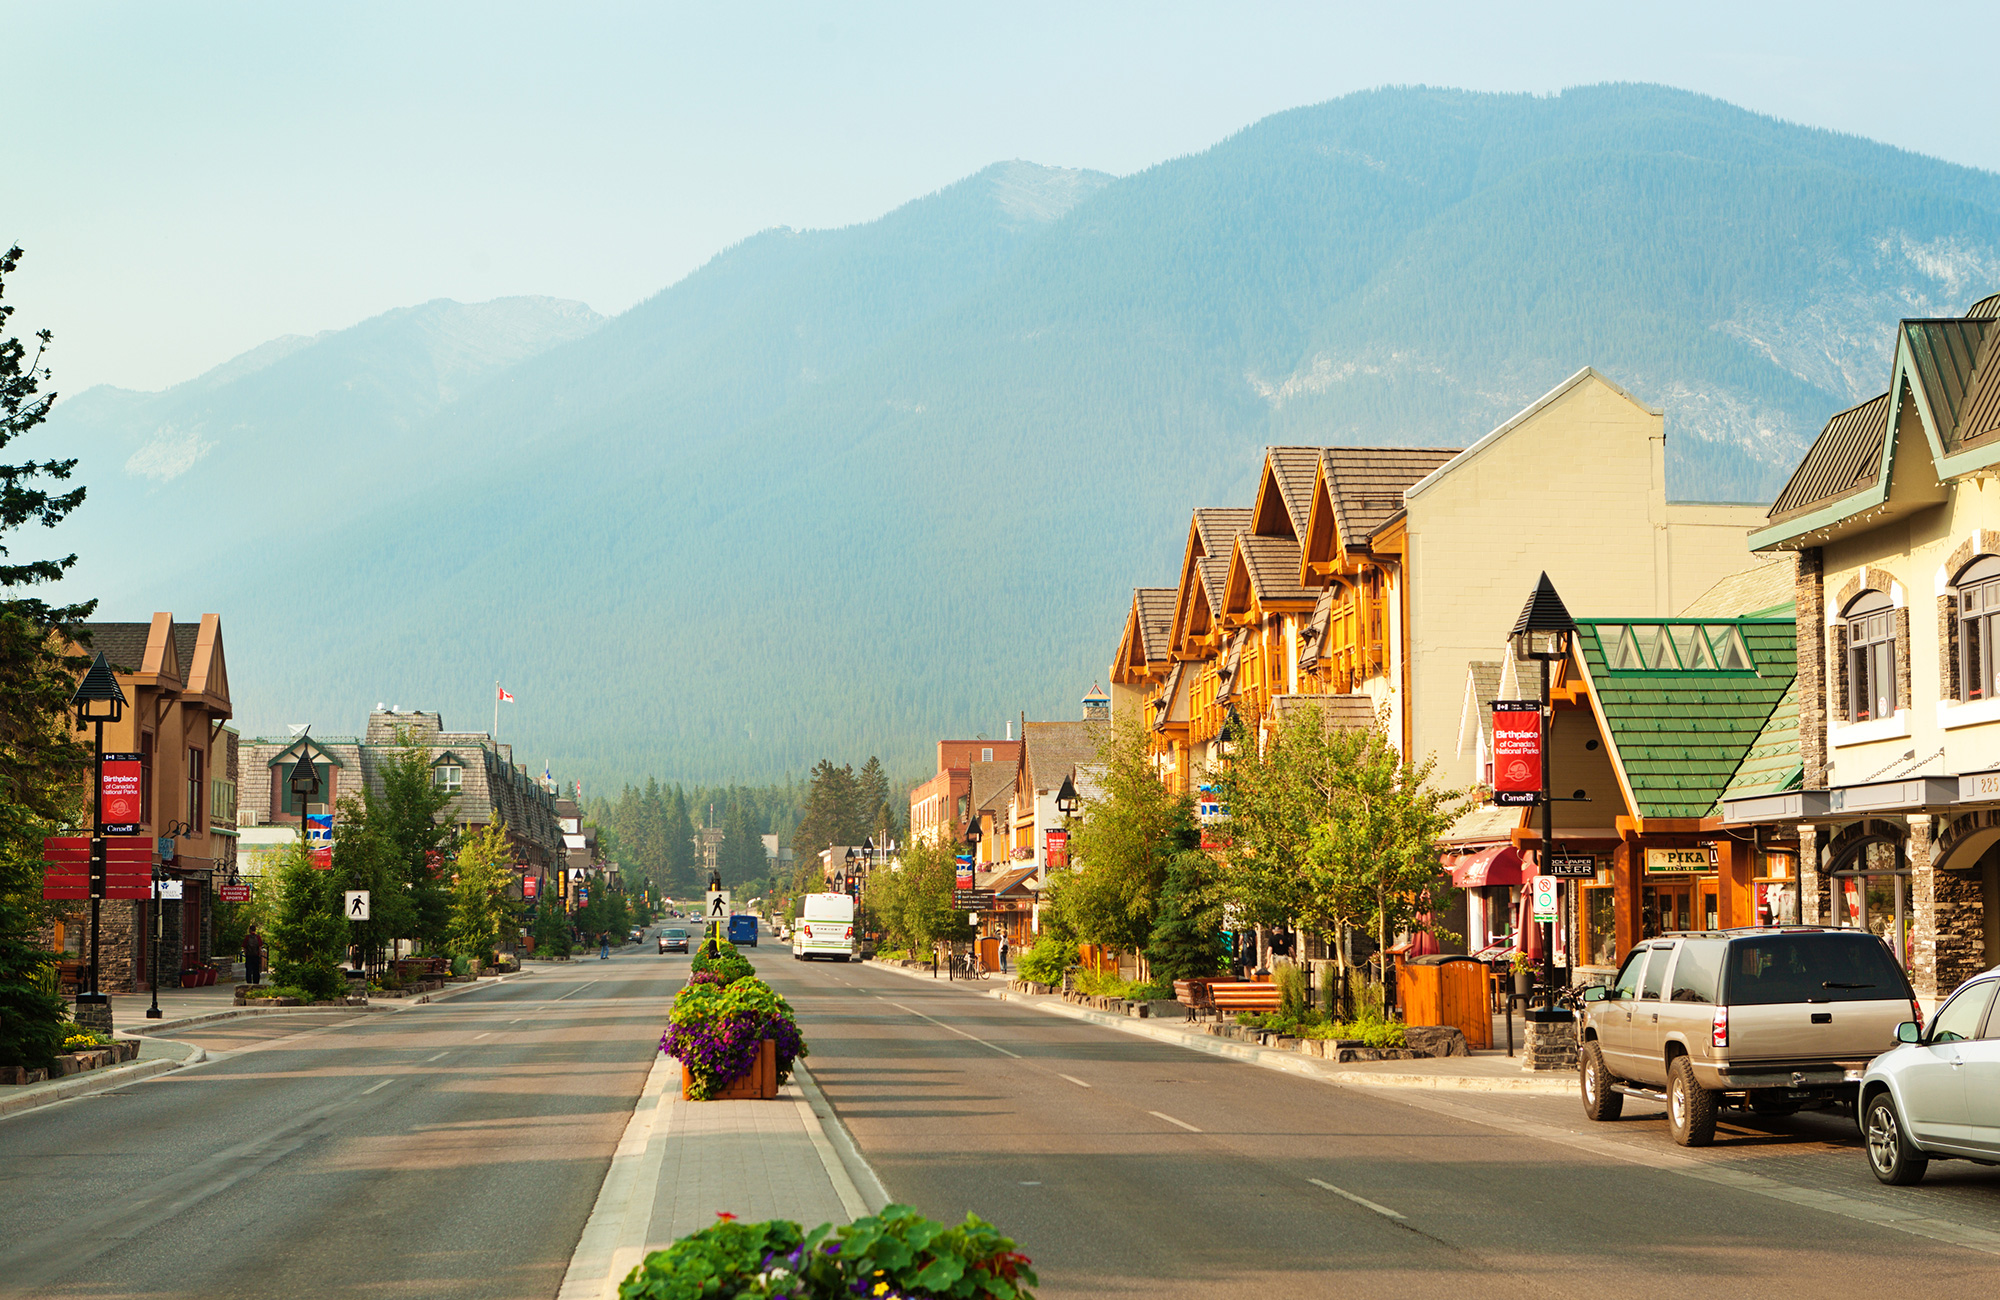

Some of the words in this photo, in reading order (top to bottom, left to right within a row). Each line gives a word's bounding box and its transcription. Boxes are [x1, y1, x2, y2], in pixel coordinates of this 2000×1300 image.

[1496, 730, 1538, 740] Birthplace
[1981, 777, 1999, 793] 225
[1502, 793, 1534, 802] Canada
[1668, 853, 1705, 862] PIKA
